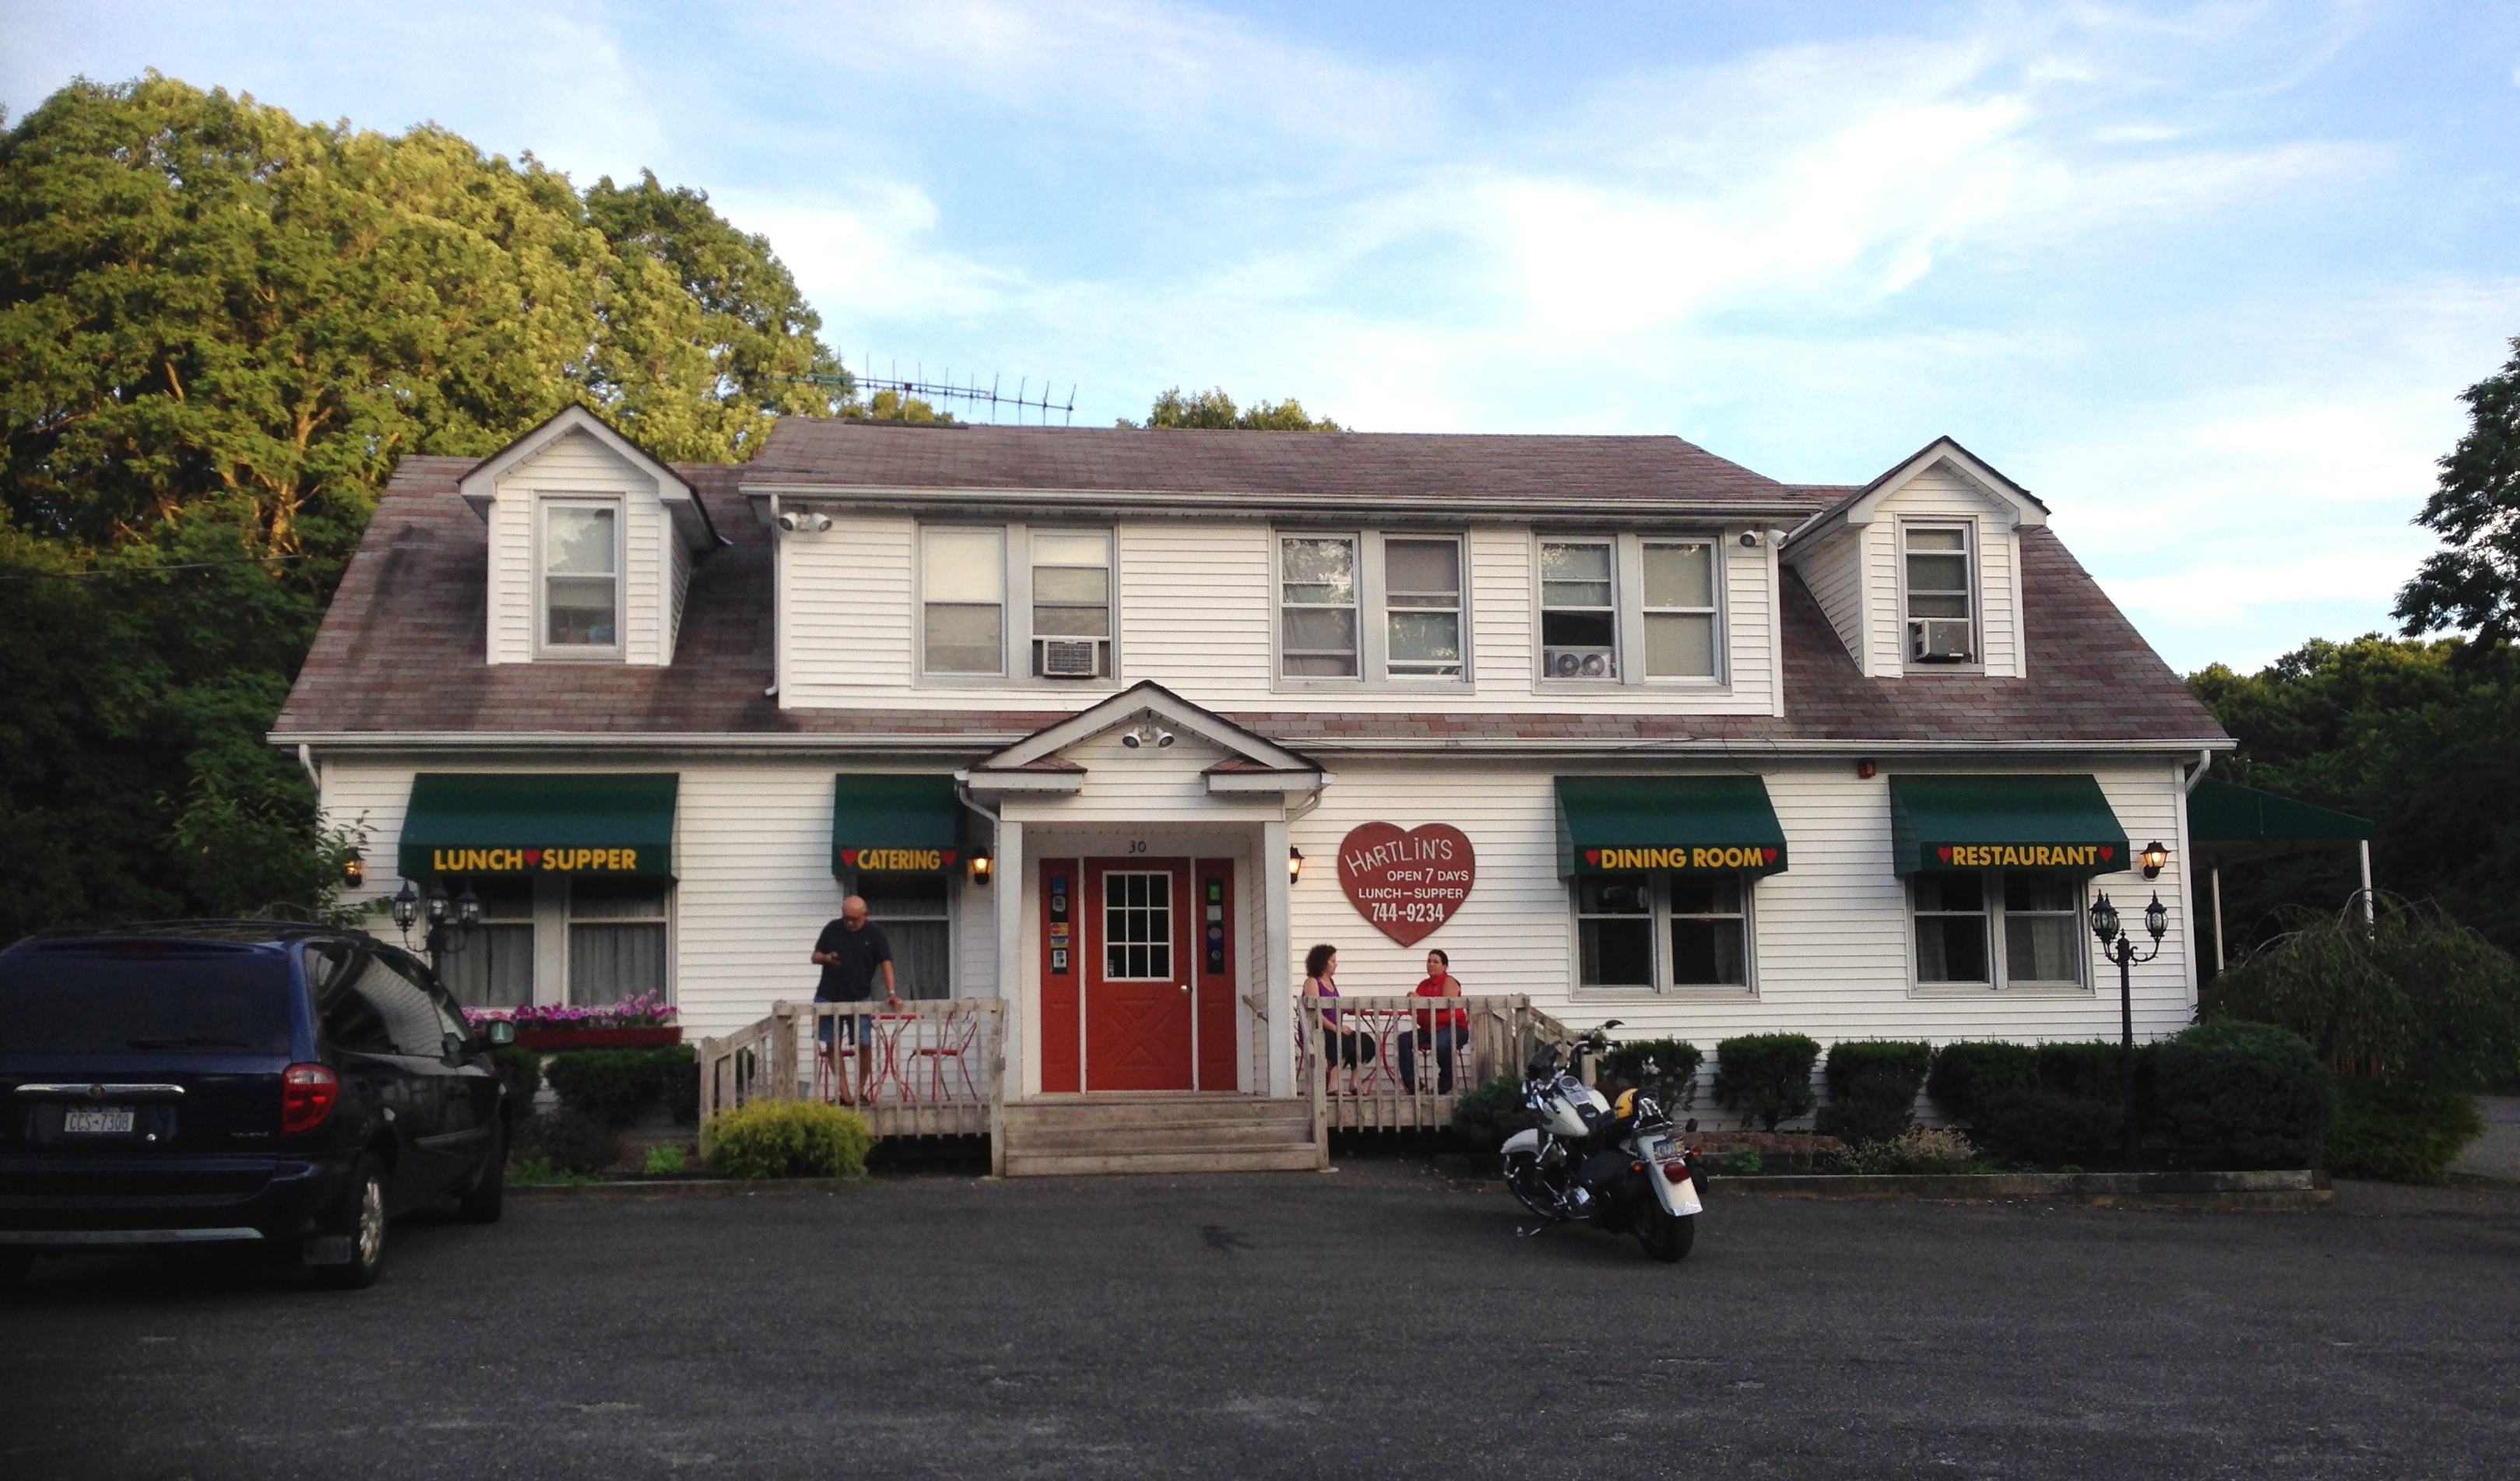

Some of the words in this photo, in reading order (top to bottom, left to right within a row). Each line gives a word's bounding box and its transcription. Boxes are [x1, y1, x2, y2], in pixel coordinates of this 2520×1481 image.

[1129, 840, 1147, 853] 30
[434, 849, 522, 870] LUNCH
[542, 849, 636, 870] SUPPER
[857, 849, 940, 870] CATERING
[1601, 848, 1686, 869] DINING
[1692, 848, 1763, 868] ROOM
[1952, 847, 2097, 865] RESTAURANT
[1387, 871, 1422, 881] OPEN
[1425, 869, 1434, 883] 7
[1438, 871, 1469, 881] DAYS
[1372, 903, 1444, 921] 744-9234
